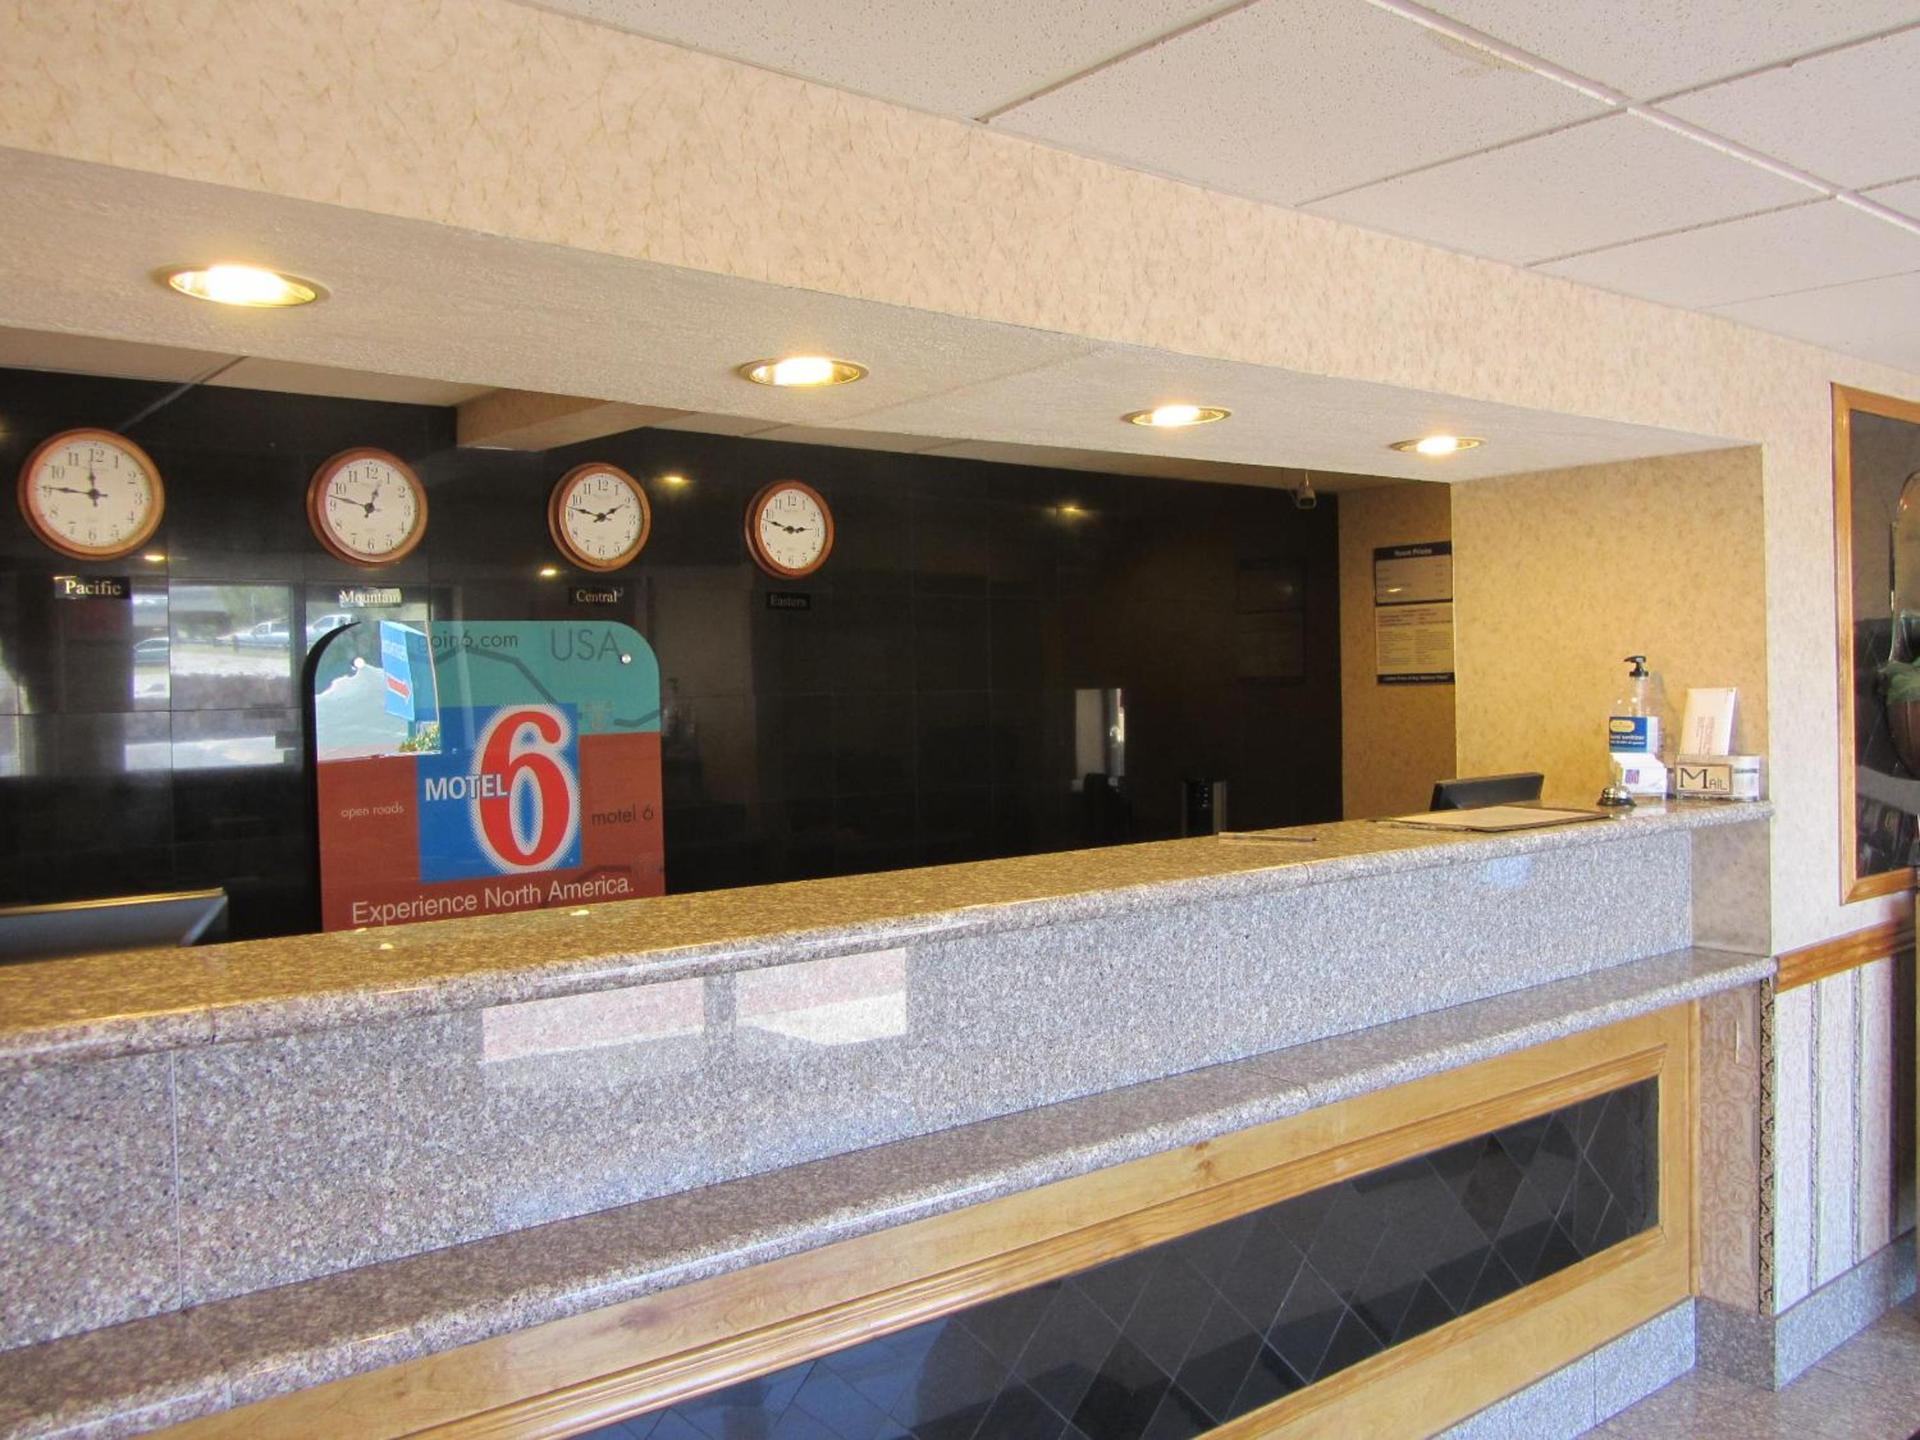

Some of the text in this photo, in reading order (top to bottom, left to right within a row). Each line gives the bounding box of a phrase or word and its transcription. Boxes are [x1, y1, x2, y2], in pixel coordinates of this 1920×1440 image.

[67, 452, 79, 466] 11
[88, 449, 104, 462] 12
[114, 455, 119, 469] 1
[51, 465, 65, 479] 10
[128, 471, 137, 485] 2
[348, 470, 358, 483] 11
[365, 466, 378, 480] 12
[386, 472, 391, 485] 1
[335, 482, 347, 495] 10
[583, 483, 591, 495] 11
[598, 479, 609, 491] 12
[615, 484, 619, 496] 1
[135, 491, 143, 505] 3
[398, 486, 406, 498] 2
[330, 501, 337, 511] 9
[572, 494, 582, 506] 10
[775, 498, 782, 509] 11
[788, 495, 797, 506] 12
[127, 510, 134, 524] 4
[404, 505, 411, 516] 3
[68, 521, 76, 535] 7
[88, 529, 96, 541] 6
[351, 532, 358, 545] 7
[385, 534, 393, 547] 5
[368, 538, 375, 550] 6
[65, 580, 122, 596] Pacific
[340, 589, 401, 604] Mountain
[576, 589, 617, 603] Central
[551, 628, 621, 661] USA
[425, 703, 578, 872] MOTEL 6
[341, 801, 405, 820] open roads
[591, 803, 655, 825] motel 6
[352, 875, 635, 926] Experience North America.
